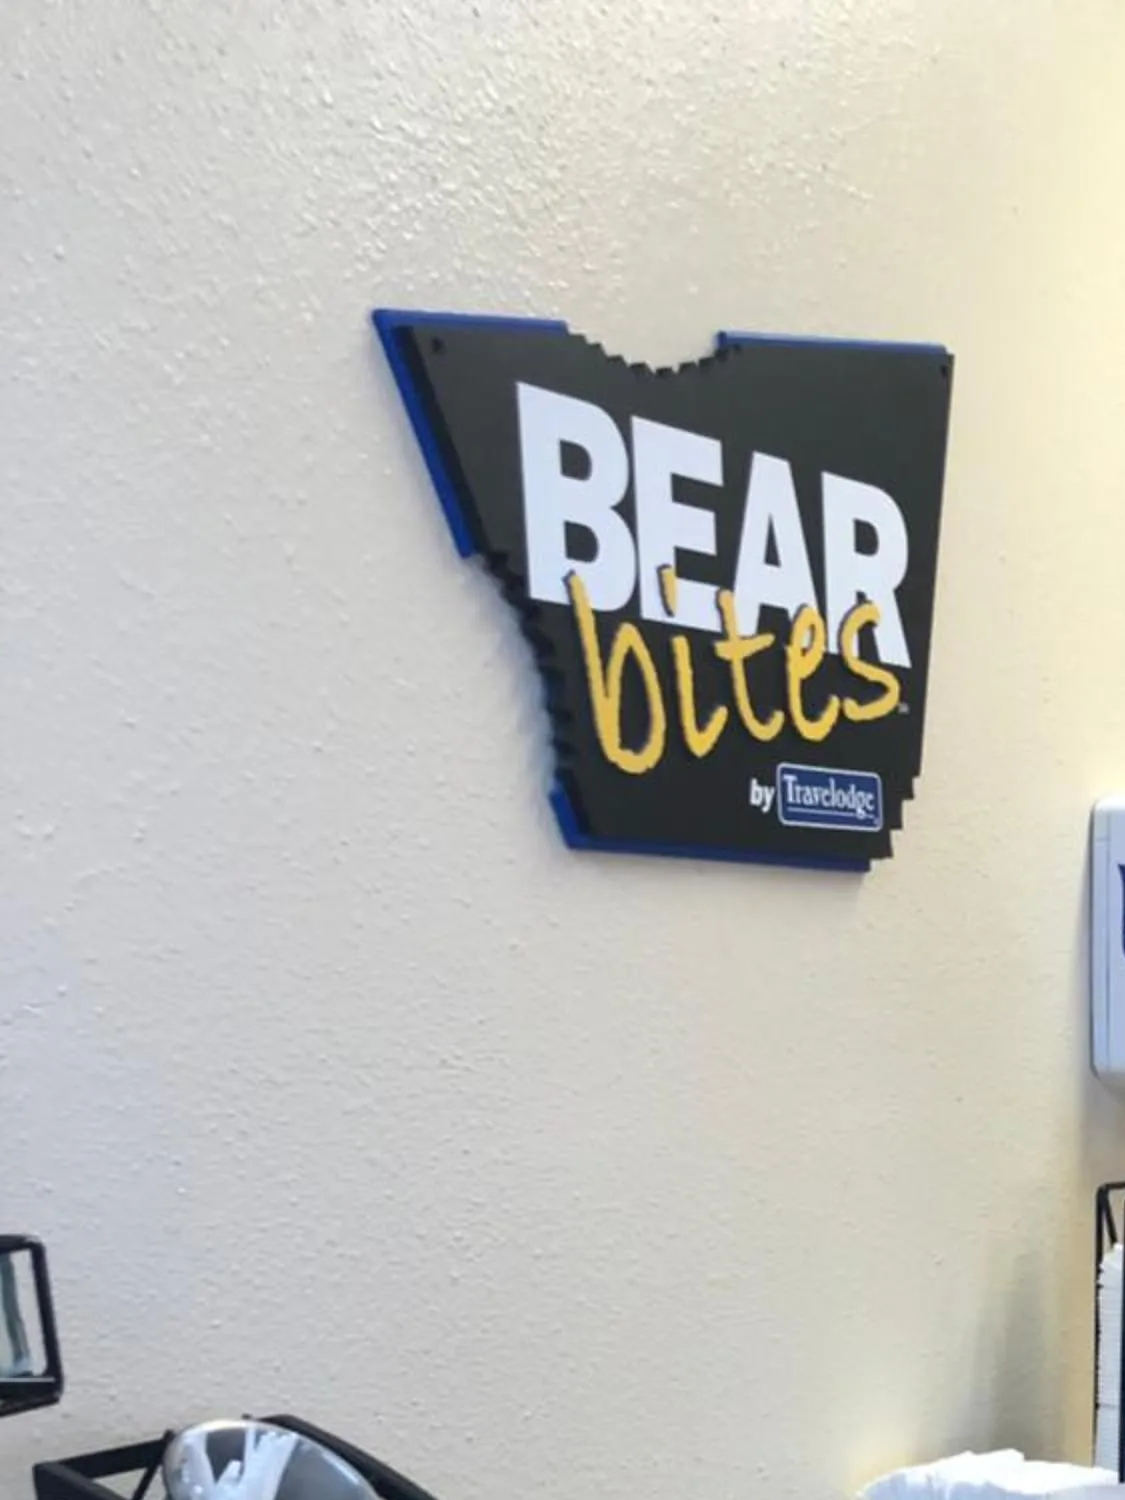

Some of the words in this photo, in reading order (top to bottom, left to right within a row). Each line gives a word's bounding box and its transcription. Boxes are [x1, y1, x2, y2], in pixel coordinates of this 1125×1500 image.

[516, 381, 911, 668] BEAR
[567, 565, 900, 774] bites
[749, 777, 775, 813] by
[782, 773, 875, 819] Travelodge
